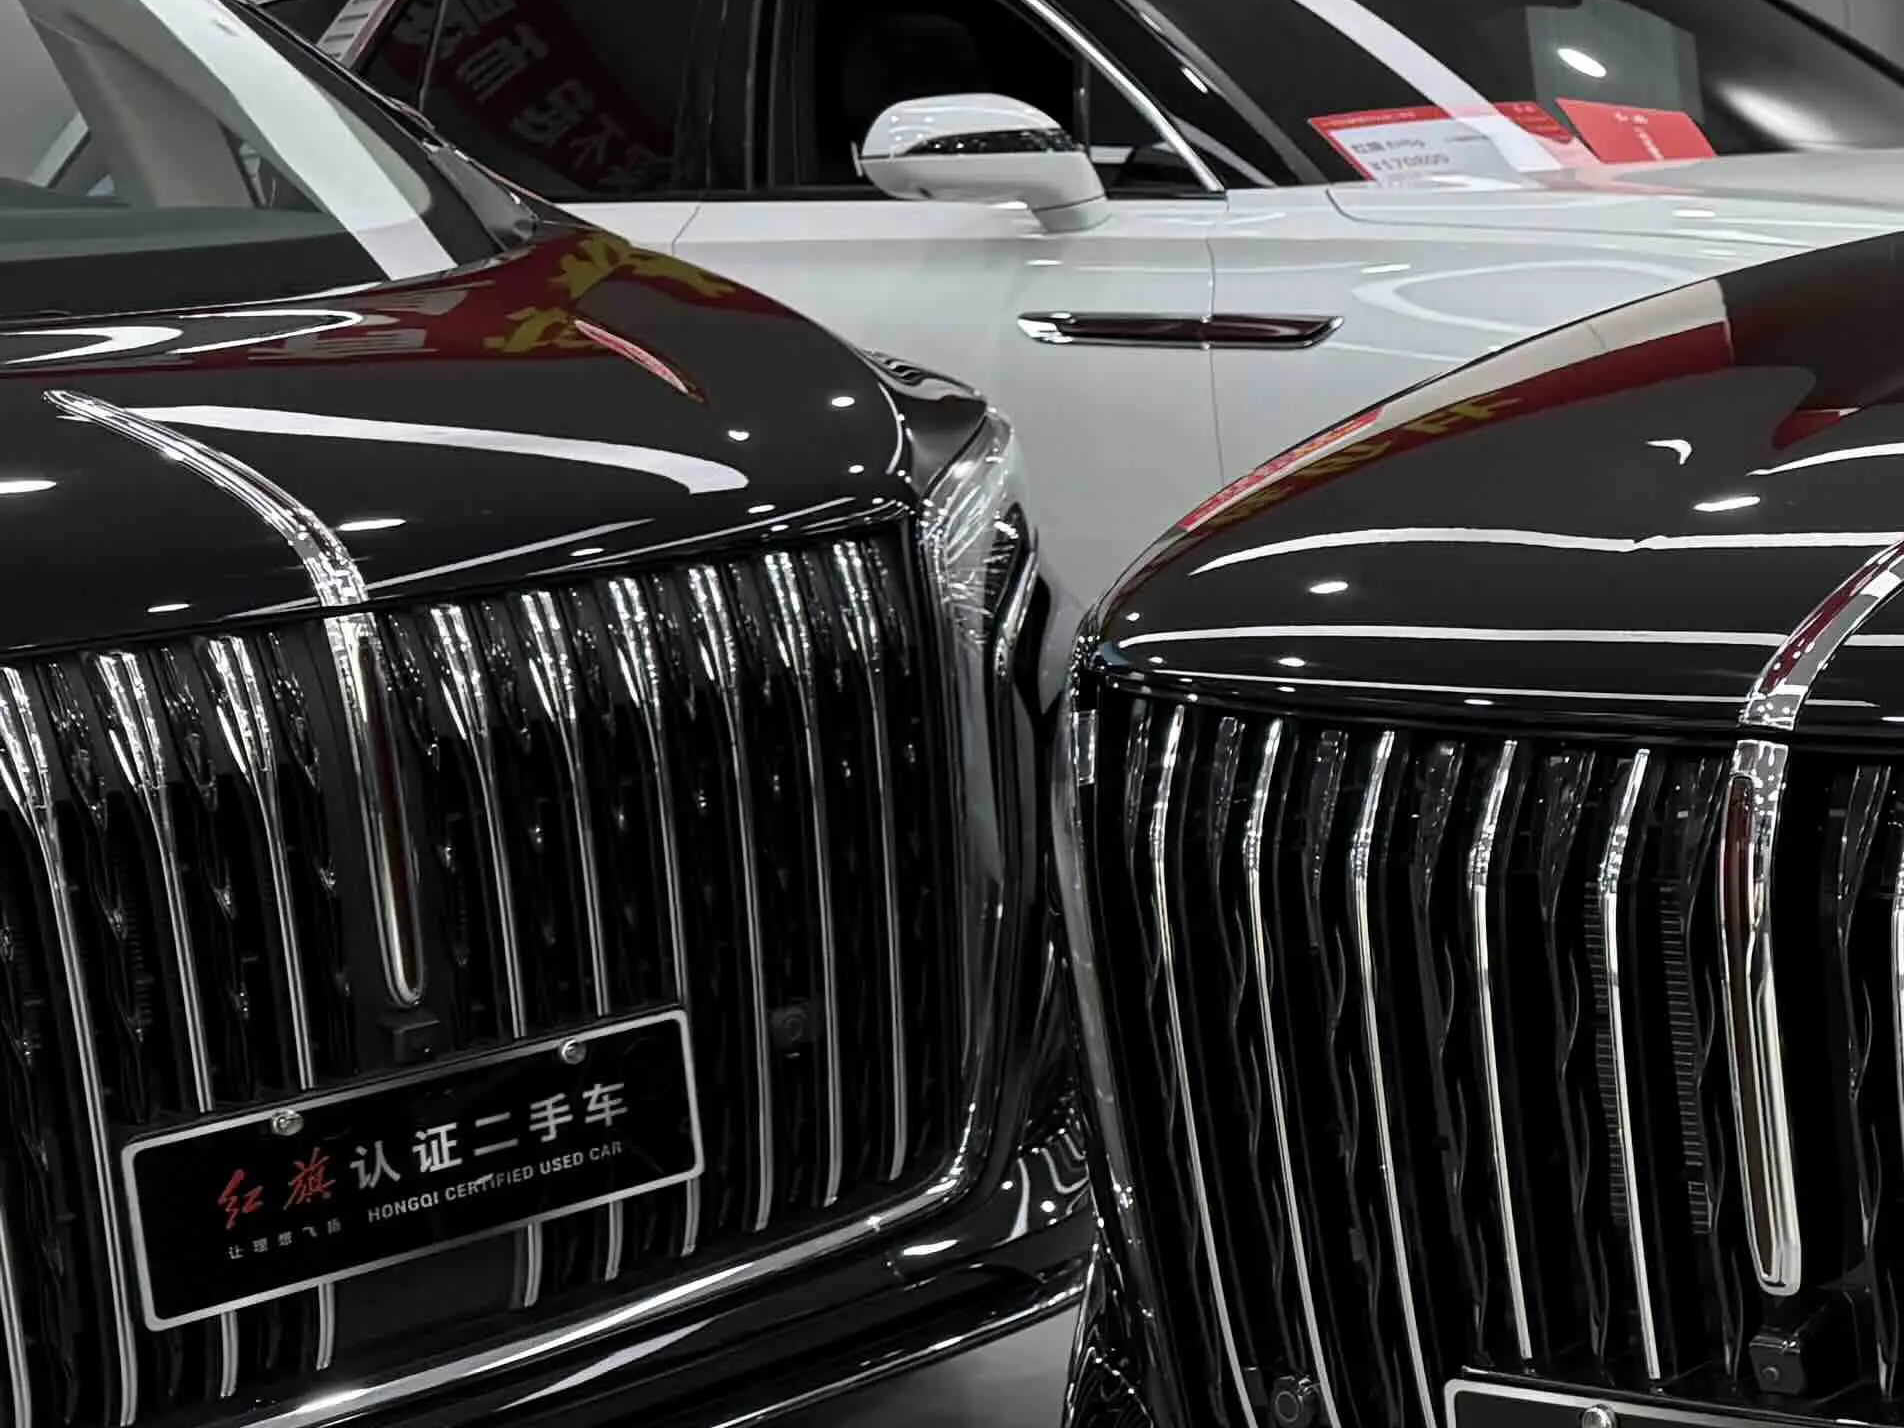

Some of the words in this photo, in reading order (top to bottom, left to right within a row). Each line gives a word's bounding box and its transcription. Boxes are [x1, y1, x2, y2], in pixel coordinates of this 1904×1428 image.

[367, 1191, 439, 1223] HONGQI
[445, 1165, 534, 1201] CERTIFIED
[539, 1151, 584, 1175] USED
[589, 1140, 623, 1161] CAR
